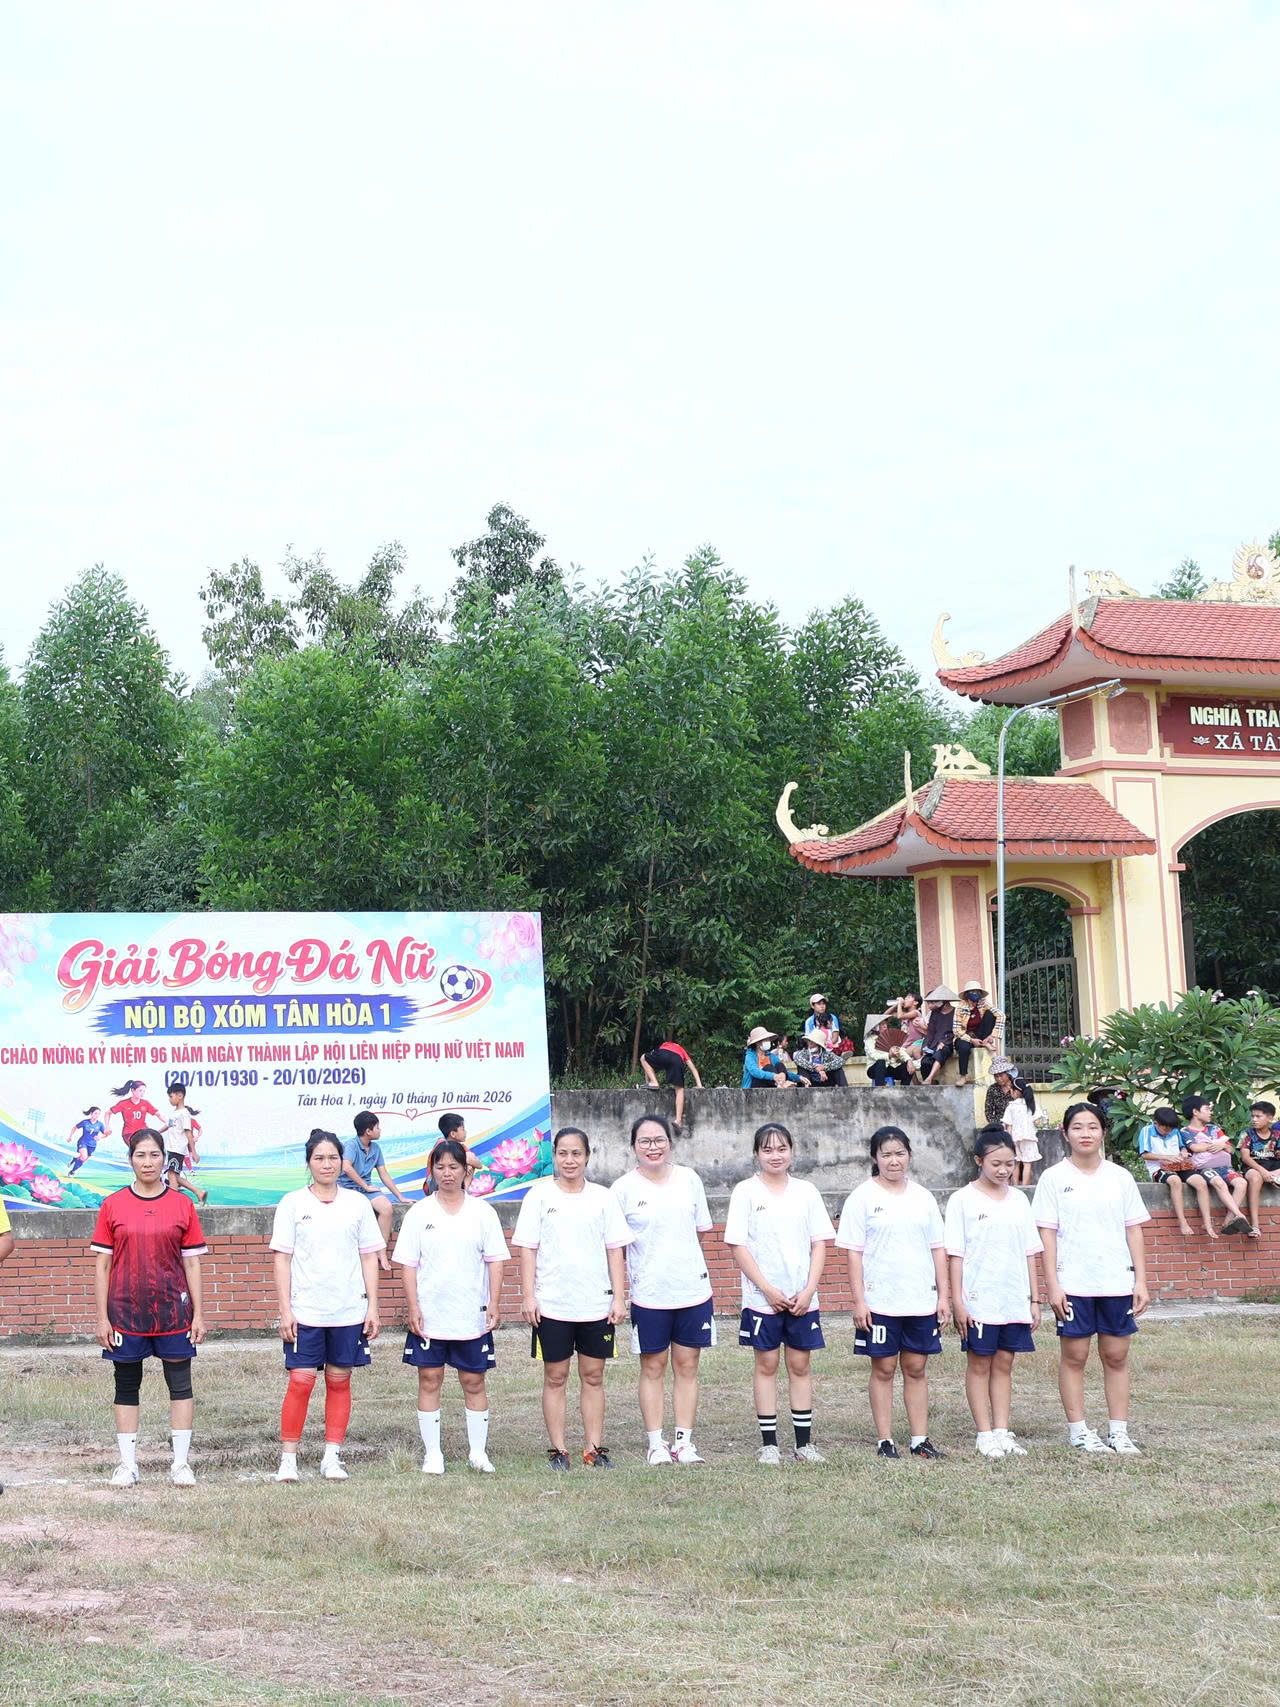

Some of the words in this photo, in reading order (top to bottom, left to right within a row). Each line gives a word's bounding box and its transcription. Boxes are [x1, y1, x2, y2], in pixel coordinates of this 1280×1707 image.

[1190, 703, 1242, 727] NGHĨA
[1246, 708, 1280, 728] TRA
[1214, 731, 1245, 750] XÃ
[1249, 732, 1280, 752] TÂ
[58, 939, 160, 1009] Giải
[163, 938, 283, 992] Bóng
[286, 937, 360, 982] Đá
[366, 936, 435, 984] Nữ
[124, 1000, 166, 1034] NỘI
[174, 1000, 206, 1034] BỘ
[213, 999, 266, 1028] XÓM
[273, 999, 319, 1027] TÂN
[326, 998, 373, 1025] HÒA
[379, 1002, 390, 1026] 1
[0, 1043, 38, 1065] CHÀO
[42, 1042, 84, 1065] MỪNG
[89, 1041, 106, 1064] KỶ
[111, 1043, 146, 1067] NIỆM
[151, 1046, 167, 1064] 96
[171, 1042, 203, 1063] NĂM
[207, 1042, 242, 1063] NGÀY
[247, 1041, 291, 1062] THÀNH
[295, 1040, 319, 1064] LẬP
[323, 1041, 346, 1064] HỘI
[349, 1040, 378, 1061] LIÊN
[382, 1040, 411, 1063] HIỆP
[415, 1042, 440, 1062] PHỤ
[445, 1039, 465, 1059] NỮ
[466, 1039, 491, 1062] VIỆT
[495, 1041, 525, 1059] NAM
[164, 1070, 258, 1088] (20/10/1930
[273, 1067, 366, 1086] 20/10/2026)
[297, 1094, 318, 1106] Tân
[359, 1092, 387, 1109] ngày
[391, 1092, 404, 1104] 10
[407, 1091, 438, 1107] tháng
[441, 1091, 454, 1103] 10
[456, 1092, 479, 1103] năm
[483, 1090, 512, 1103] 2026
[132, 1111, 142, 1119] 10
[752, 1315, 763, 1336] 7
[872, 1324, 887, 1344] 10
